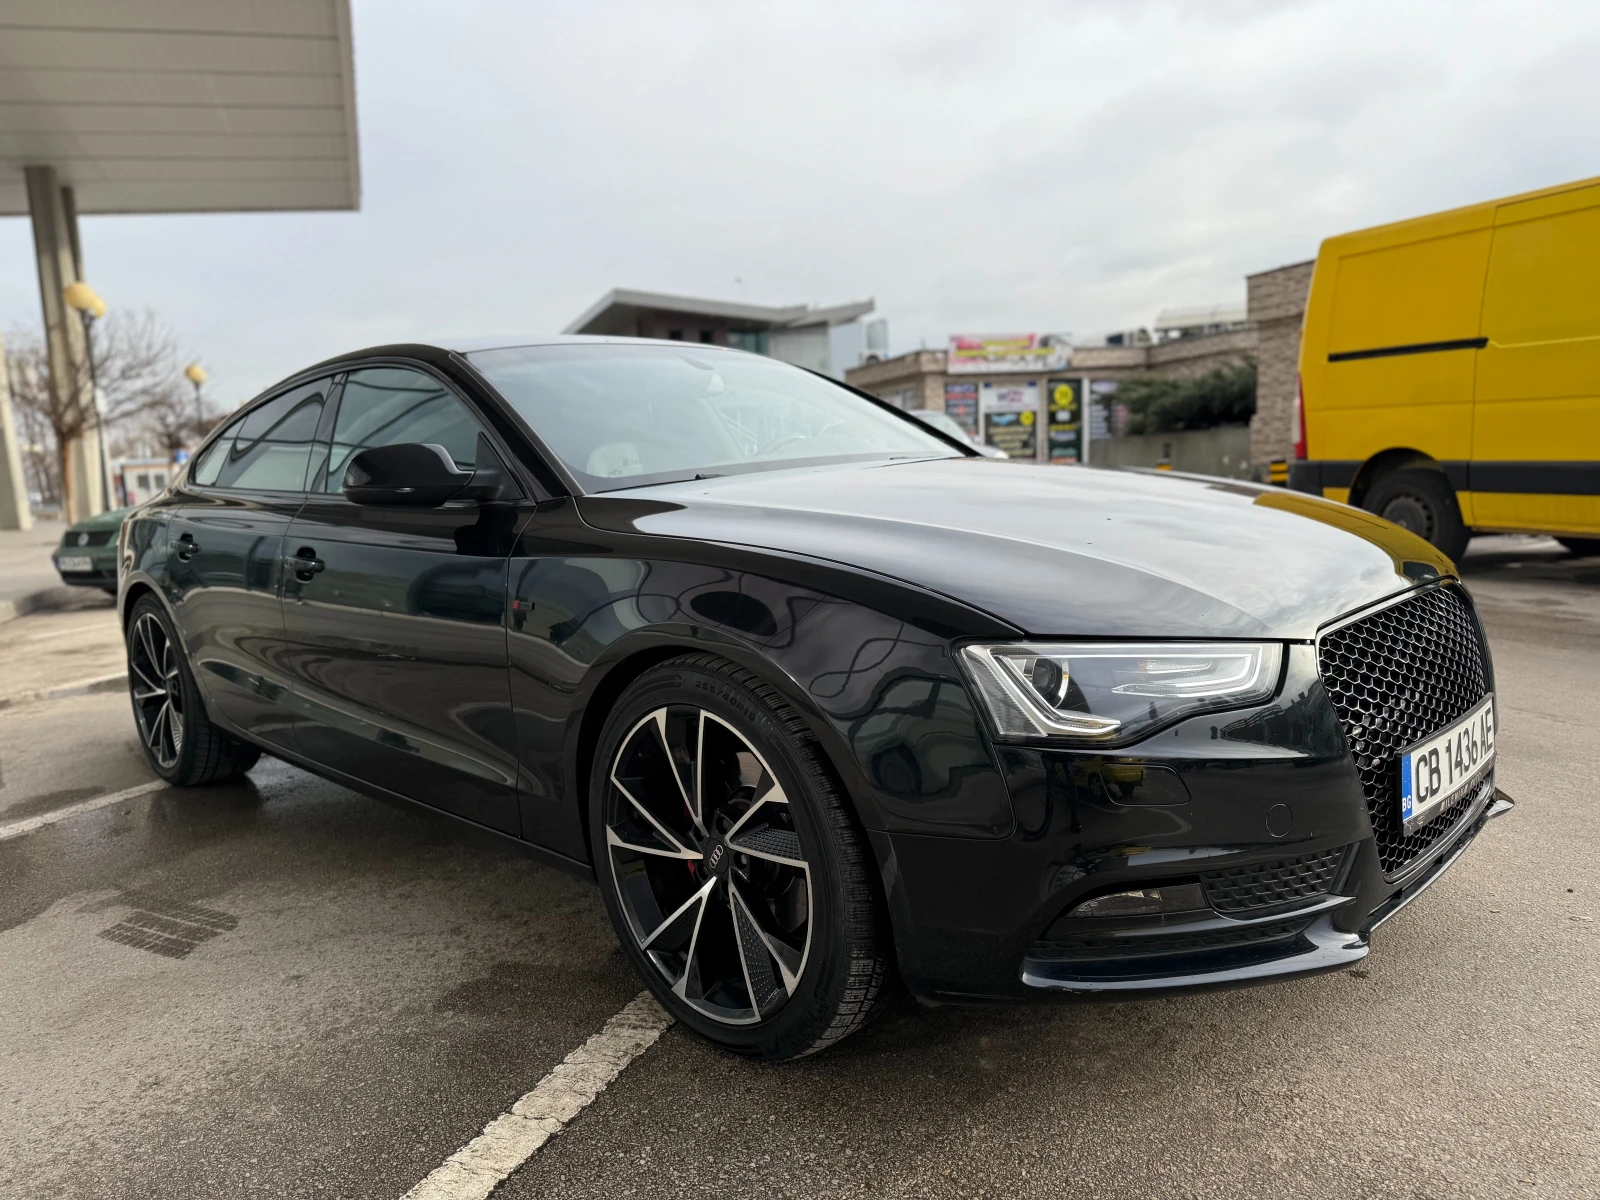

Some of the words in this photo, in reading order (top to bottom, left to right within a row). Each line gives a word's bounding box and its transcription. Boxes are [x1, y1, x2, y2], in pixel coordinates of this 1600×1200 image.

[1415, 747, 1441, 803] CB
[1445, 720, 1478, 785] 1436
[1479, 706, 1493, 760] AE
[1402, 795, 1412, 812] BG
